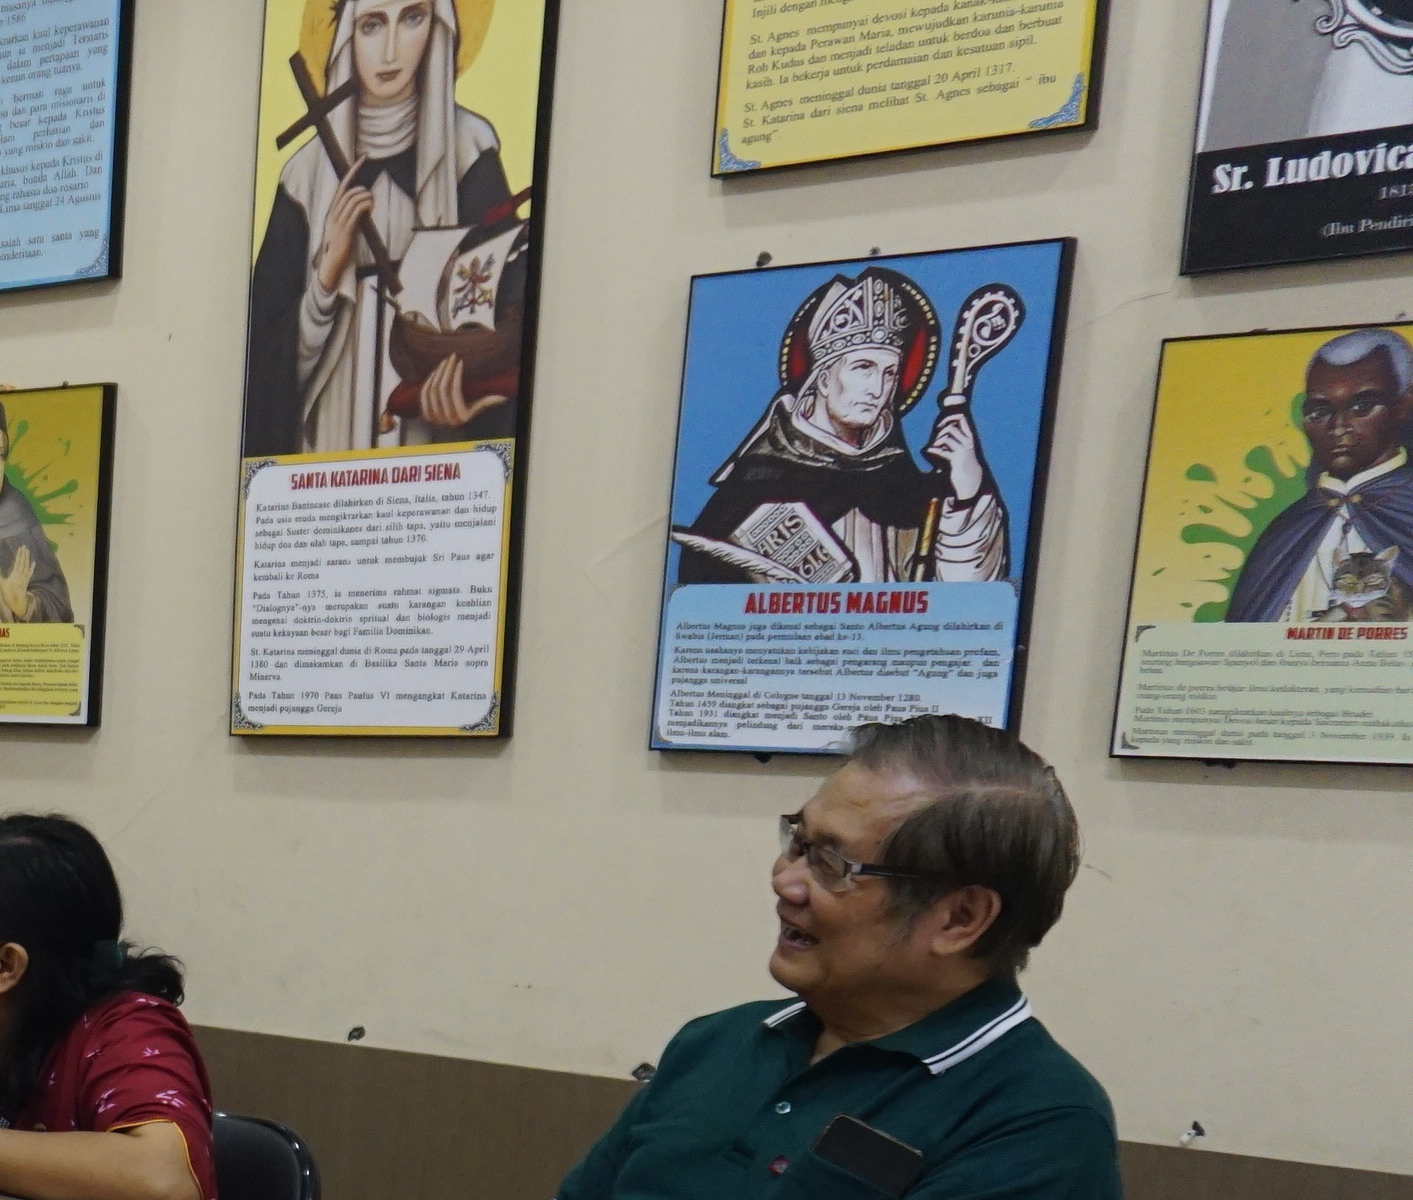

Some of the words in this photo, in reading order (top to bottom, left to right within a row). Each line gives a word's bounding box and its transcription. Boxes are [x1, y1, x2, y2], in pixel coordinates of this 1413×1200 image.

[1212, 163, 1255, 194] Sr.
[291, 471, 327, 490] SANTA
[330, 467, 388, 487] KATARINA
[391, 465, 421, 483] DARI
[424, 462, 460, 481] SIENA
[745, 591, 841, 614] ALBERTUS
[845, 590, 928, 613] MAGNUS
[1286, 627, 1335, 640] MARTIN
[1337, 627, 1353, 640] DE
[1356, 626, 1408, 640] PORRES
